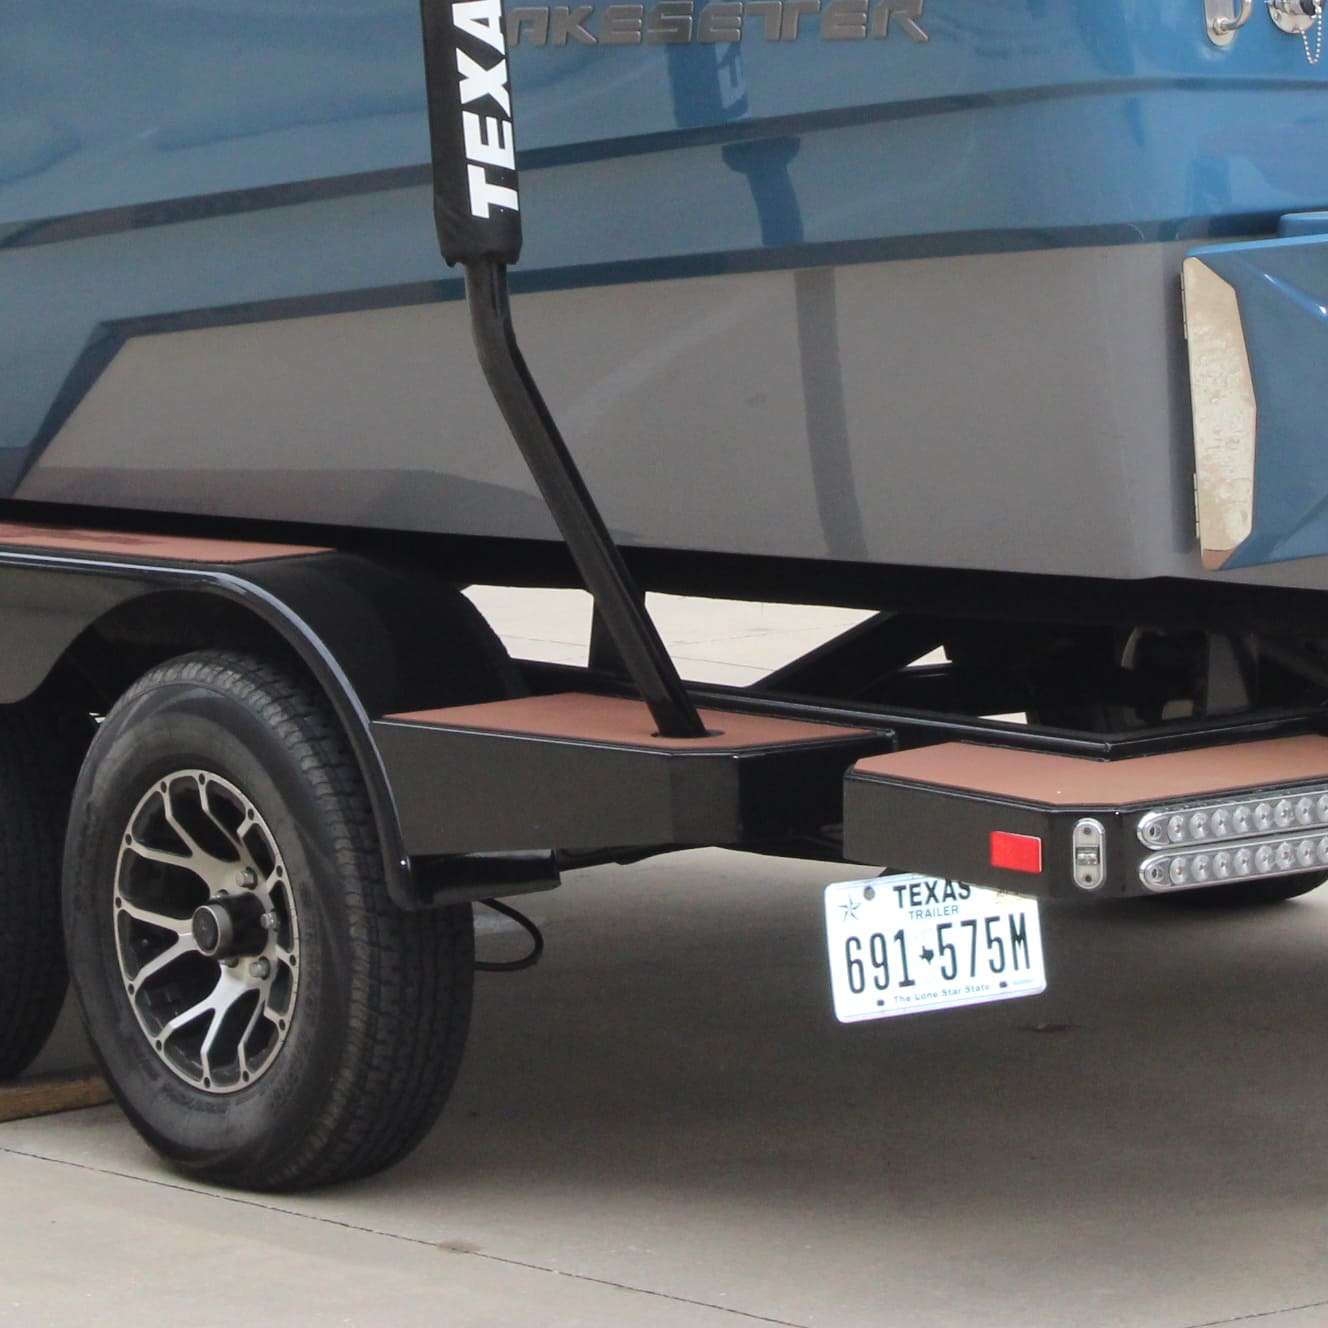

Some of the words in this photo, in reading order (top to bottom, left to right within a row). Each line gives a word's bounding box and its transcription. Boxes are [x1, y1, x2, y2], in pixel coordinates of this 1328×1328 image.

[893, 879, 971, 908] TEXAS
[908, 904, 960, 921] TRAILER
[845, 929, 916, 995] 691
[936, 912, 1032, 981] 575M
[941, 986, 962, 998] Star
